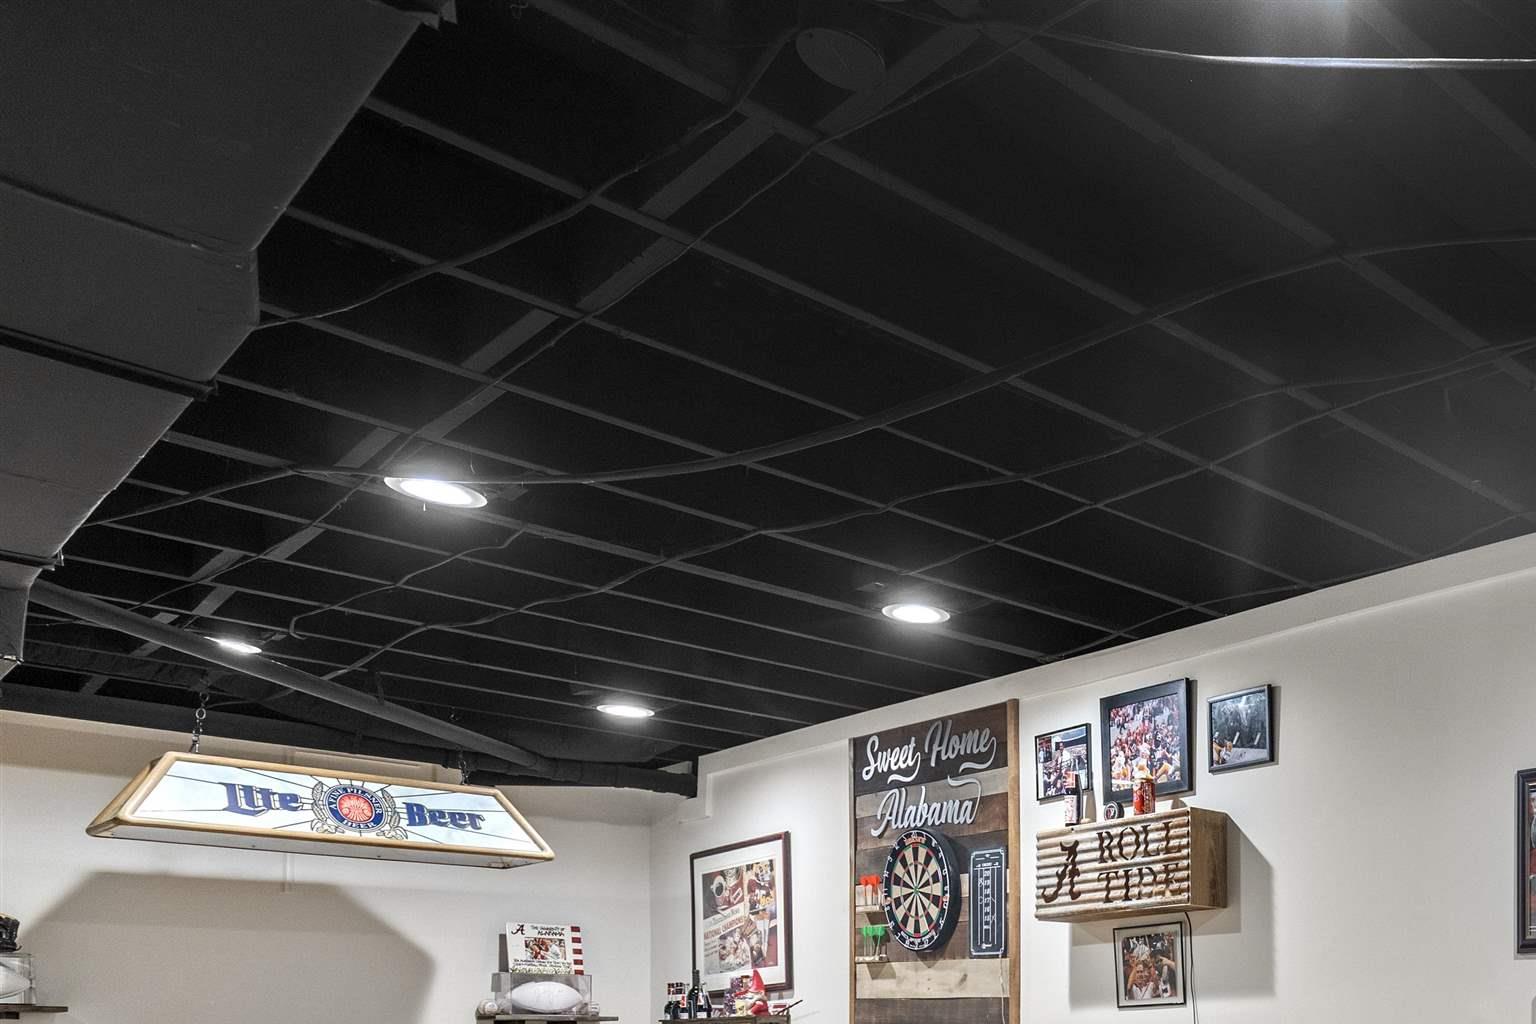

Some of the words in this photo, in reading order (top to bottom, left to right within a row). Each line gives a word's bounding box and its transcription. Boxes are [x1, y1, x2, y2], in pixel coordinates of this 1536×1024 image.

[862, 735, 920, 784] Sweet
[924, 719, 997, 773] Home
[346, 787, 382, 814] PILSNER
[402, 801, 486, 831] Beer
[870, 775, 981, 836] Alabama
[1096, 820, 1182, 865] ROLL
[1042, 840, 1081, 904] A
[1097, 863, 1181, 904] TIDE
